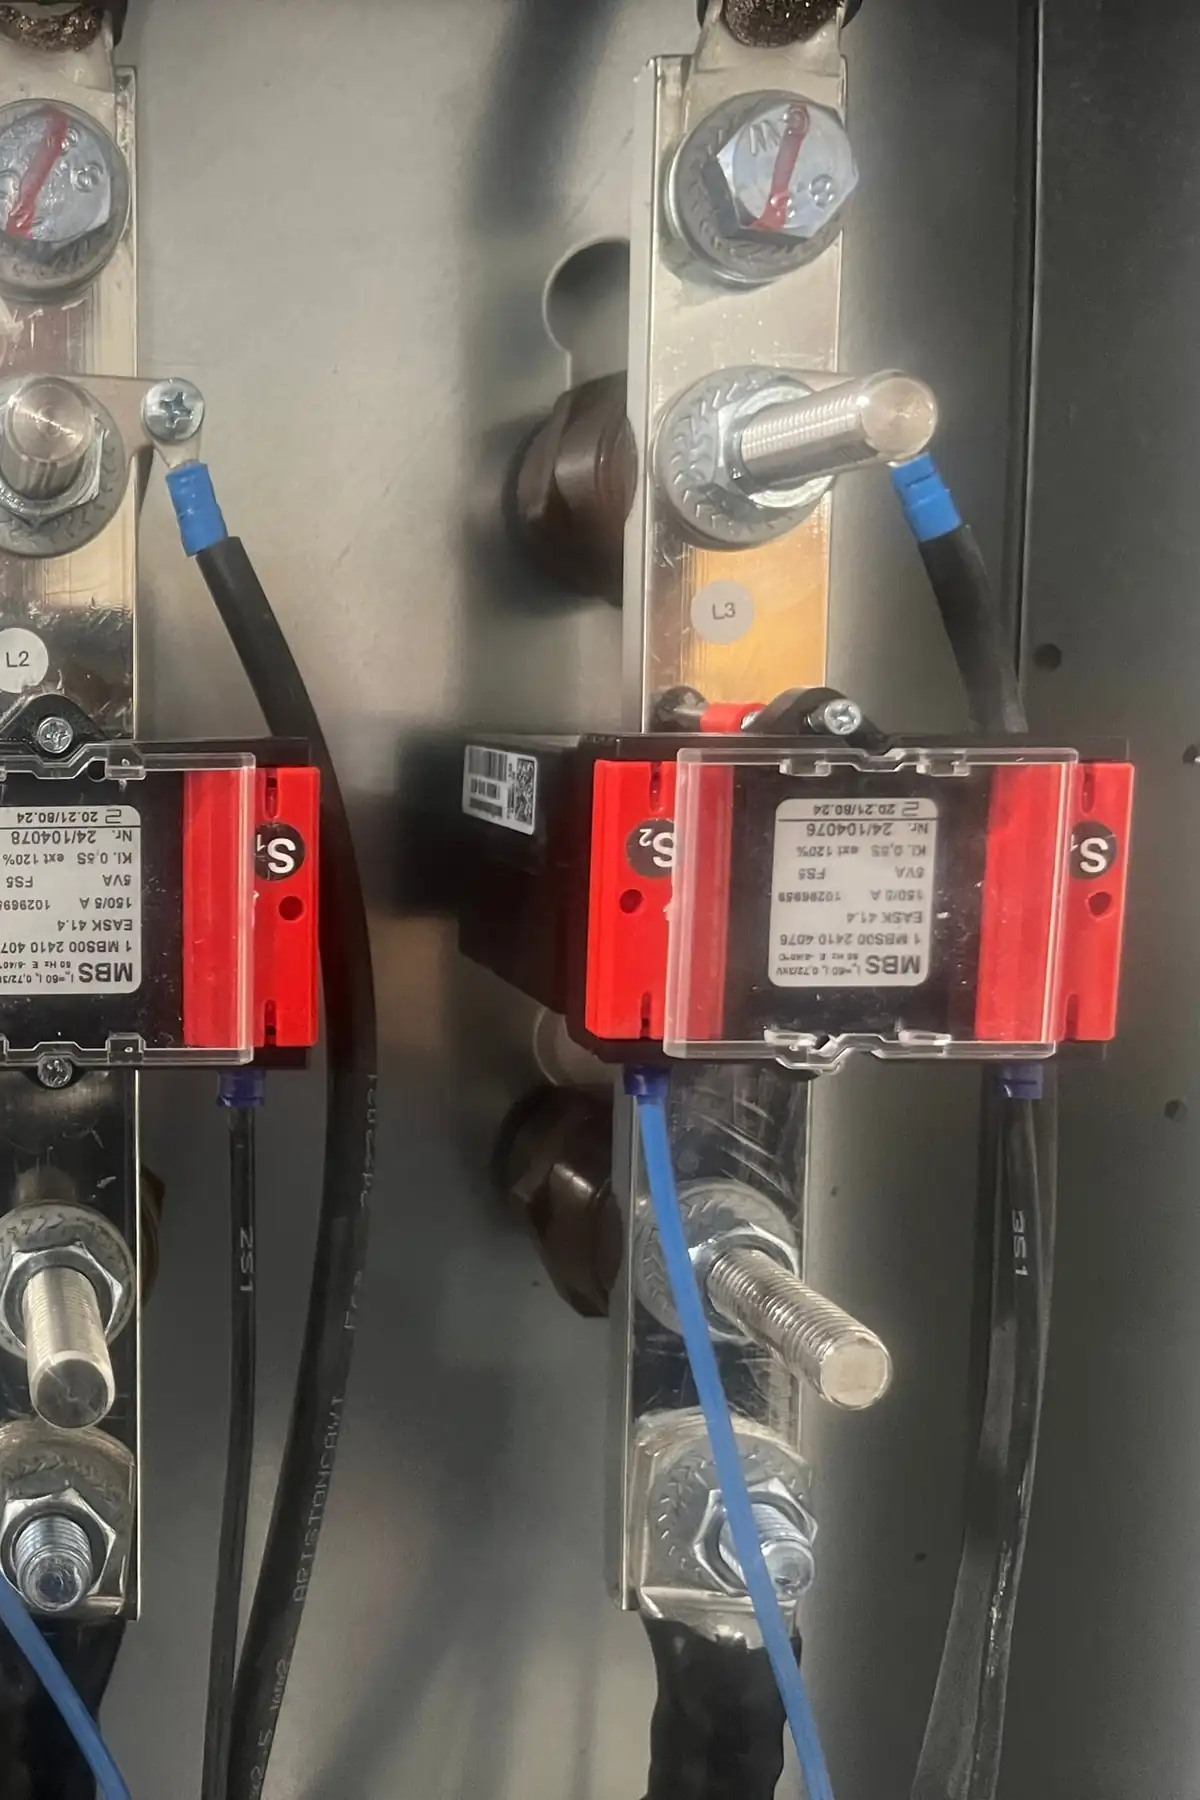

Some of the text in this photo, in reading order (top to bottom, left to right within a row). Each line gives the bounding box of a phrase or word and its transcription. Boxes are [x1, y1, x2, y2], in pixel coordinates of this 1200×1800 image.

[712, 602, 736, 620] L3
[5, 651, 30, 668] L2
[17, 812, 98, 823] 20.21/80.24
[806, 823, 894, 836] 24/104076
[11, 830, 132, 845] Nr. 24/104078
[257, 834, 296, 873] S1
[639, 828, 675, 868] S2
[796, 846, 832, 857] 120%
[838, 846, 859, 855] ext
[1070, 834, 1108, 873] S1
[3, 854, 38, 865] 120%
[44, 854, 64, 863] ext
[77, 851, 108, 864] 0,5S
[798, 866, 924, 880] 5VA FS5
[6, 875, 131, 888] 5VA FS5
[870, 890, 880, 900] A
[885, 890, 924, 900] 150/5
[80, 897, 90, 909] A
[95, 897, 132, 909] 150/5
[847, 912, 923, 923] EASK 41.4
[58, 920, 132, 931] EASK 41.4
[780, 935, 814, 945] 4076
[819, 934, 852, 945] 2410
[857, 933, 908, 945] MBS00
[31, 941, 64, 953] 2410
[69, 941, 119, 952] MBS00
[125, 941, 132, 952] 1
[865, 955, 920, 974] MBS
[78, 963, 133, 982] MBS
